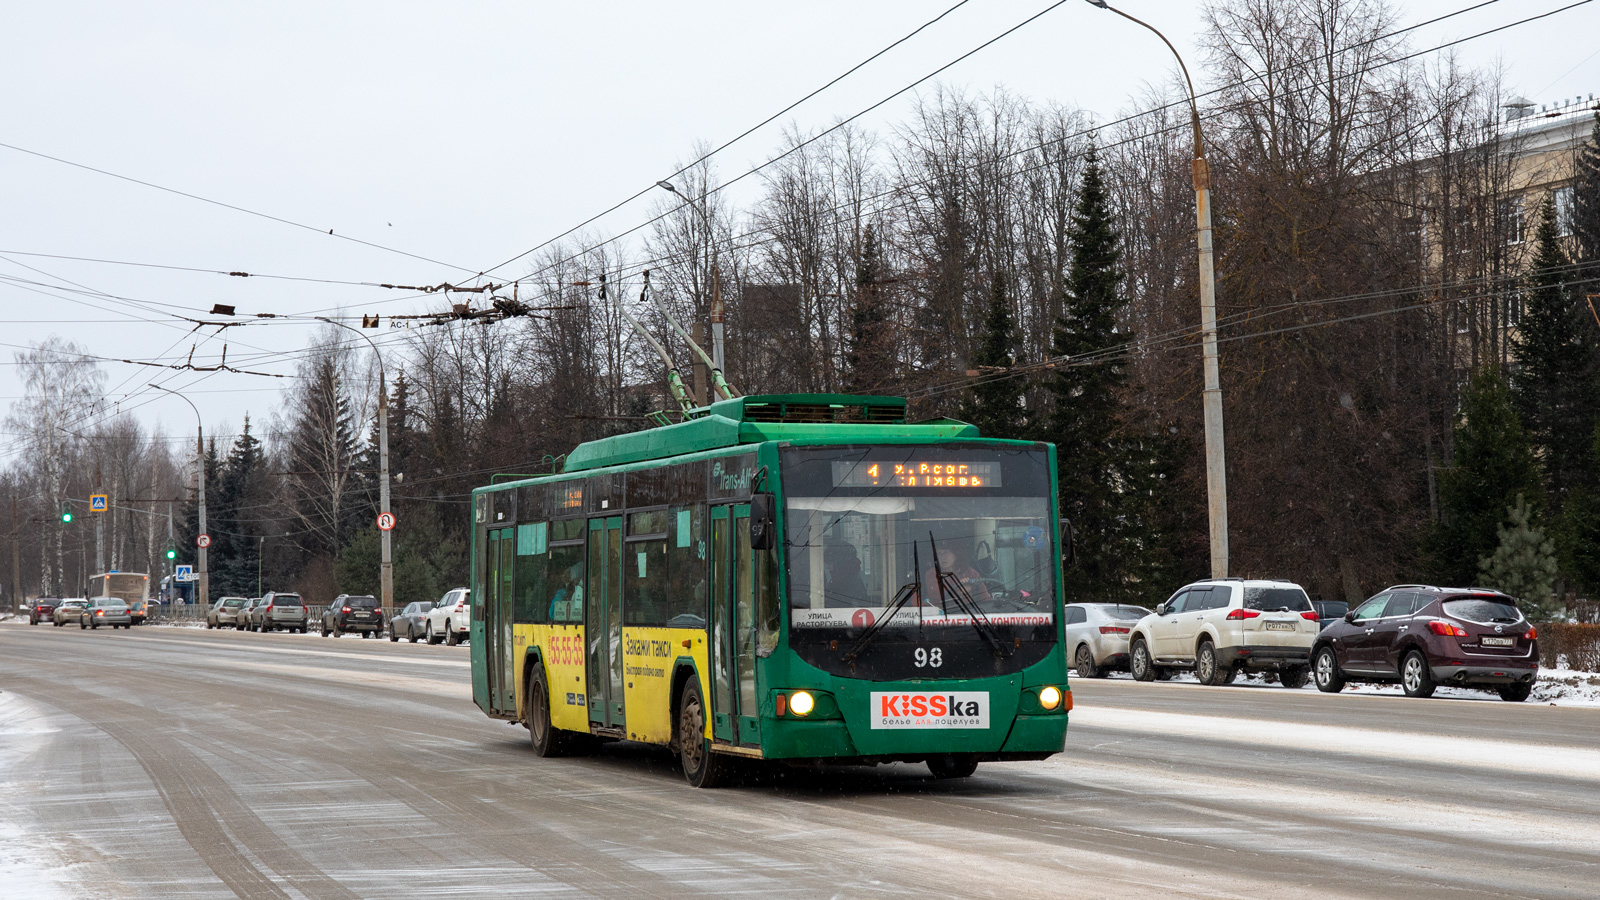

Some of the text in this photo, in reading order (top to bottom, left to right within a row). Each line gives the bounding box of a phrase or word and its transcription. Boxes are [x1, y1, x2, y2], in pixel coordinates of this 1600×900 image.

[868, 464, 878, 477] 1
[697, 540, 706, 560] 98
[796, 620, 848, 628] РАСТОРГУЕВА
[858, 611, 867, 627] 1
[990, 616, 1050, 626] КОНДУКТОРА
[625, 632, 671, 657] Закажи такси
[914, 647, 943, 668] 98
[882, 718, 911, 726] белье
